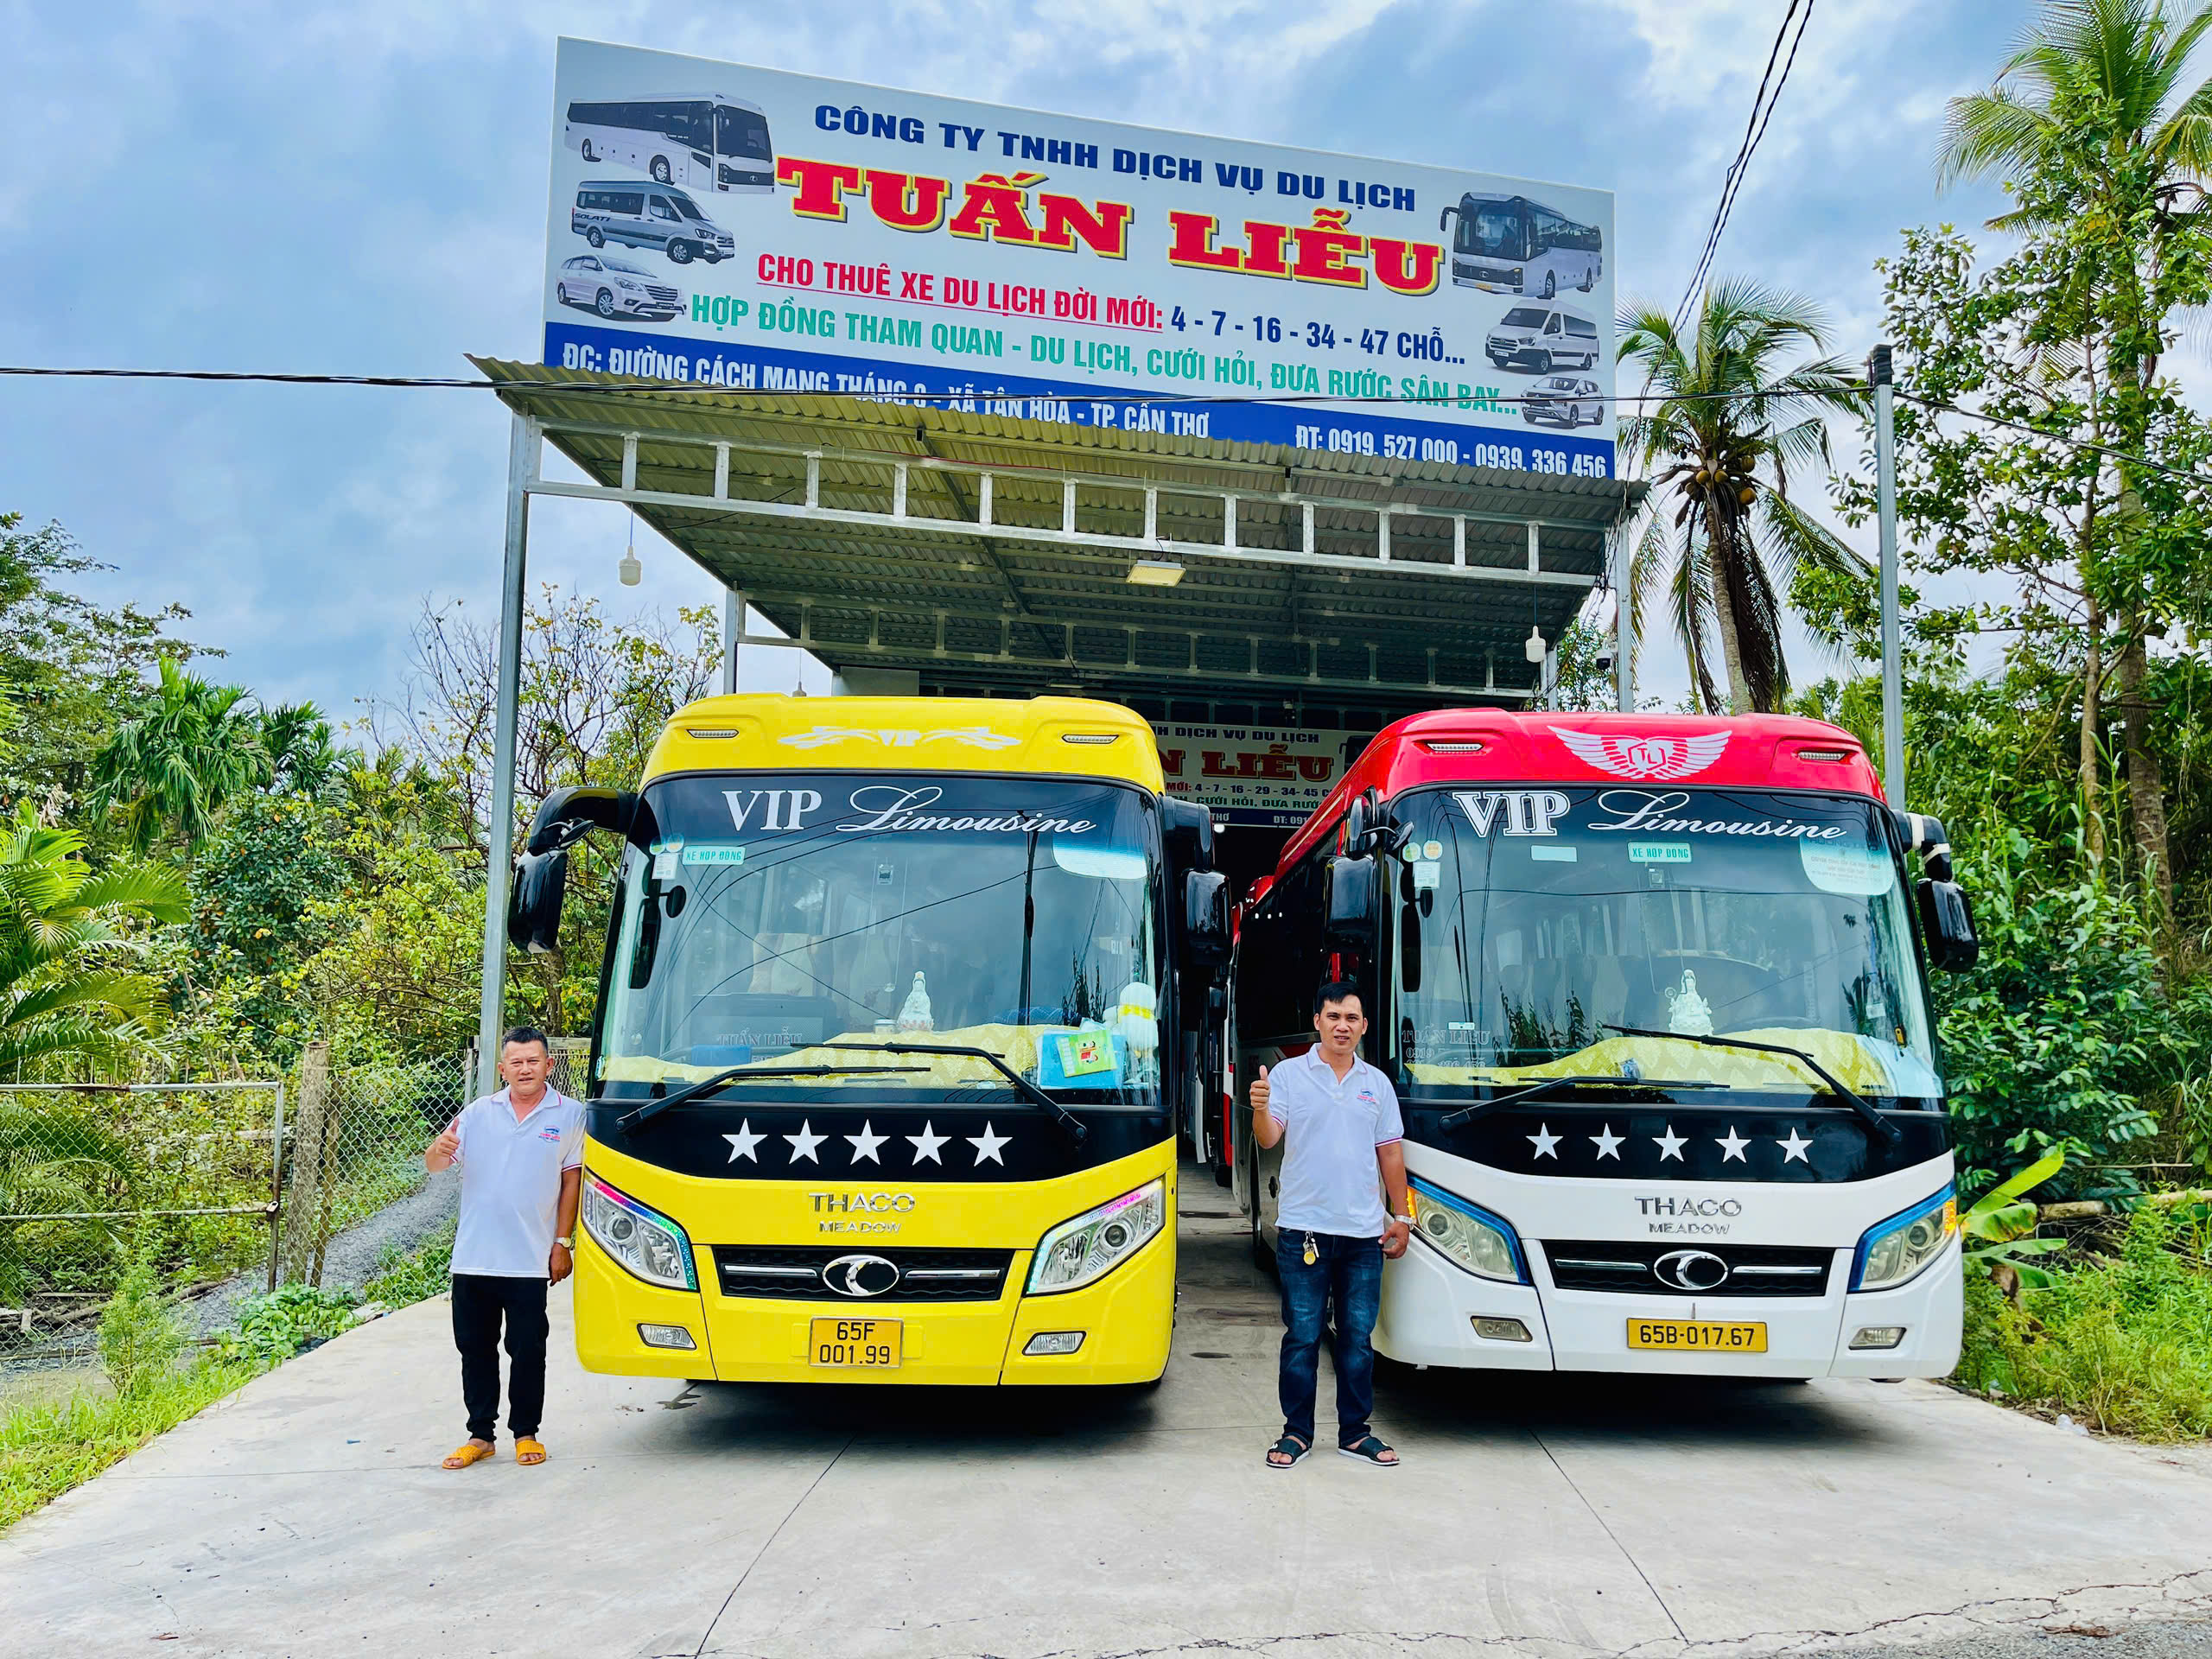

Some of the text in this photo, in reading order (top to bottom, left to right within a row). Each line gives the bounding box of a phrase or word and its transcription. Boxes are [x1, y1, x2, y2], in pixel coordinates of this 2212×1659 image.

[815, 105, 1415, 212] CÔNG TY TNHH DỊCH VỤ DU LỊCH
[575, 213, 611, 223] SOLATI
[774, 154, 1446, 296] TUẤN LIỄU
[758, 253, 813, 286] CHO
[823, 263, 891, 296] THUÊ
[900, 270, 934, 302] XE
[944, 276, 978, 307] DU
[988, 283, 1046, 316] LỊCH
[1054, 287, 1096, 321] ĐỜI
[1106, 295, 1163, 329] MỚI:
[1171, 306, 1186, 332] 4
[1211, 310, 1226, 336] 7
[1253, 315, 1281, 343] 16
[1306, 321, 1336, 349] 34
[1360, 328, 1389, 355] 47
[1396, 327, 1465, 365] CHỖ...
[691, 294, 748, 331] HỢP
[758, 296, 836, 338] ĐỒNG
[845, 312, 922, 348] THAM
[931, 323, 1002, 358] QUAN
[1030, 334, 1065, 365] DU
[1073, 340, 1137, 377] LỊCH,
[1147, 346, 1205, 381] CƯỚI
[1214, 350, 1262, 391] HỎI,
[1270, 363, 1320, 394] ĐƯA
[1328, 367, 1392, 400] RƯỚC
[1401, 374, 1449, 408] SÂN
[1457, 383, 1517, 415] BAY...
[563, 342, 602, 373] ĐC:
[608, 345, 689, 382] ĐƯỜNG
[696, 354, 756, 390] CÁCH
[836, 372, 907, 406] THÁNG
[948, 383, 976, 413] XÃ
[982, 386, 1023, 419] TÂN
[1029, 391, 1071, 424] HÒA
[1090, 402, 1117, 428] TP.
[1171, 411, 1210, 439] THƠ
[1295, 424, 1323, 450] ĐT:
[1383, 434, 1417, 461] 527
[1421, 437, 1458, 465] 000
[1532, 448, 1567, 476] 336
[1571, 454, 1606, 479] 456
[878, 728, 920, 747] VIP
[1175, 727, 1217, 739] DỊCH
[1223, 729, 1246, 741] VỤ
[1252, 731, 1275, 741] DU
[1281, 732, 1319, 744] LỊCH
[1201, 743, 1335, 782] LIỄU
[1195, 783, 1203, 792] 4
[1213, 784, 1220, 793] 7
[1230, 785, 1244, 794] 16
[1255, 785, 1270, 795] 29
[1304, 788, 1319, 797] 45
[721, 785, 1096, 834] VIP Limousine
[1262, 798, 1288, 808] ĐƯA
[1293, 799, 1321, 809] RƯỚ
[1452, 789, 1847, 840] VIP Limousine
[1632, 848, 1643, 858] XE
[809, 1192, 916, 1213] THACO
[1634, 1196, 1742, 1217] THACO
[819, 1220, 902, 1234] MEADOW
[1649, 1223, 1730, 1235] MEADOW
[836, 1321, 876, 1341] 65F
[1640, 1325, 1755, 1346] 65B-017.67
[819, 1344, 891, 1364] 001.99
